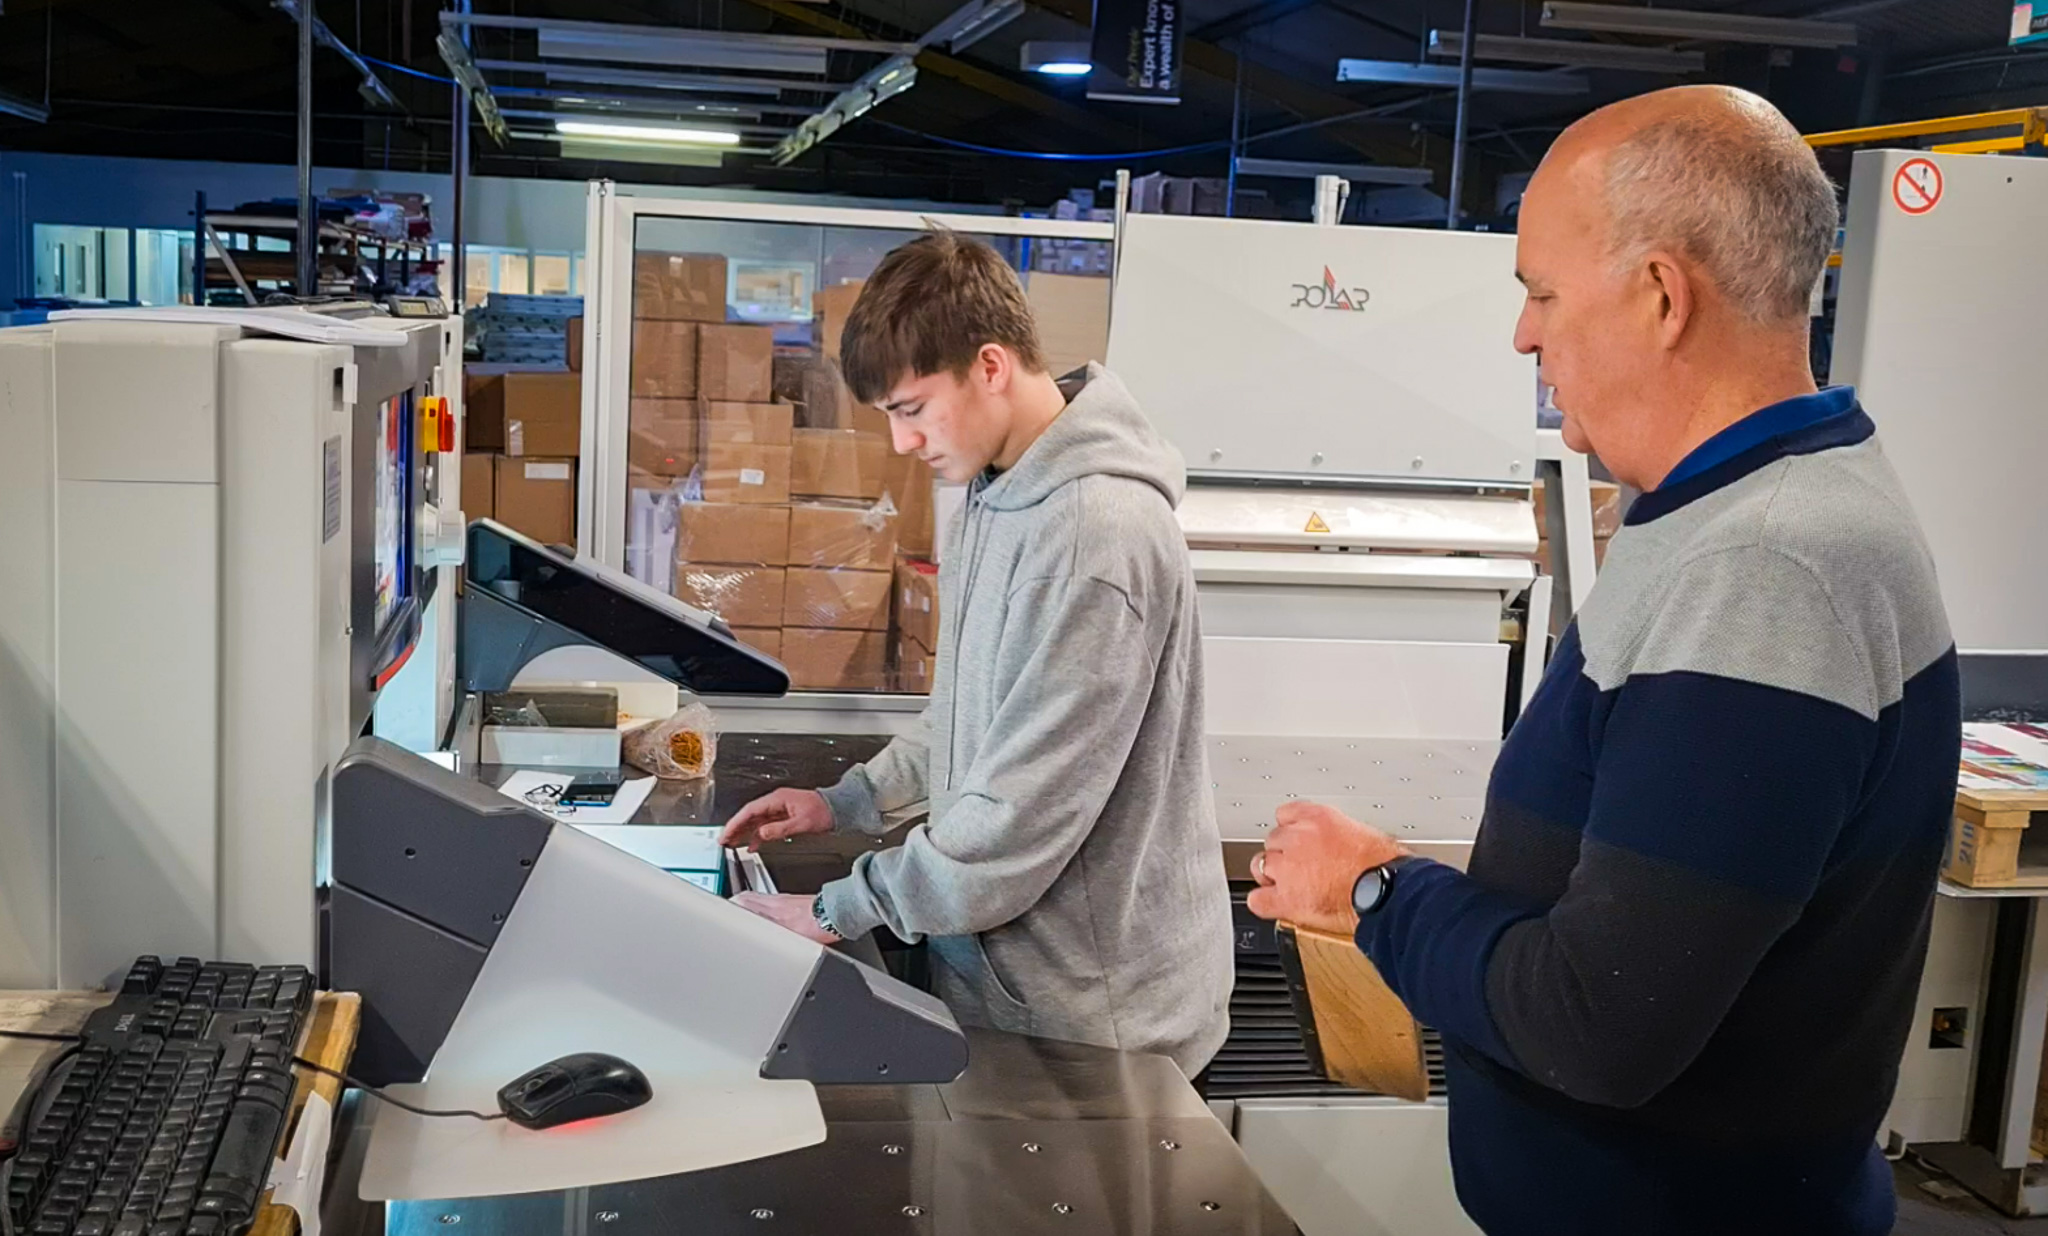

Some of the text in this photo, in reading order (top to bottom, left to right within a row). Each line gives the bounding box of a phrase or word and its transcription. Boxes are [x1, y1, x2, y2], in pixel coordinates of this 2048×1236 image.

[1162, 3, 1175, 21] of
[1140, 0, 1159, 88] Expert kno
[1160, 24, 1173, 76] wealth
[1291, 265, 1369, 311] POLAR
[114, 1013, 135, 1031] DELL
